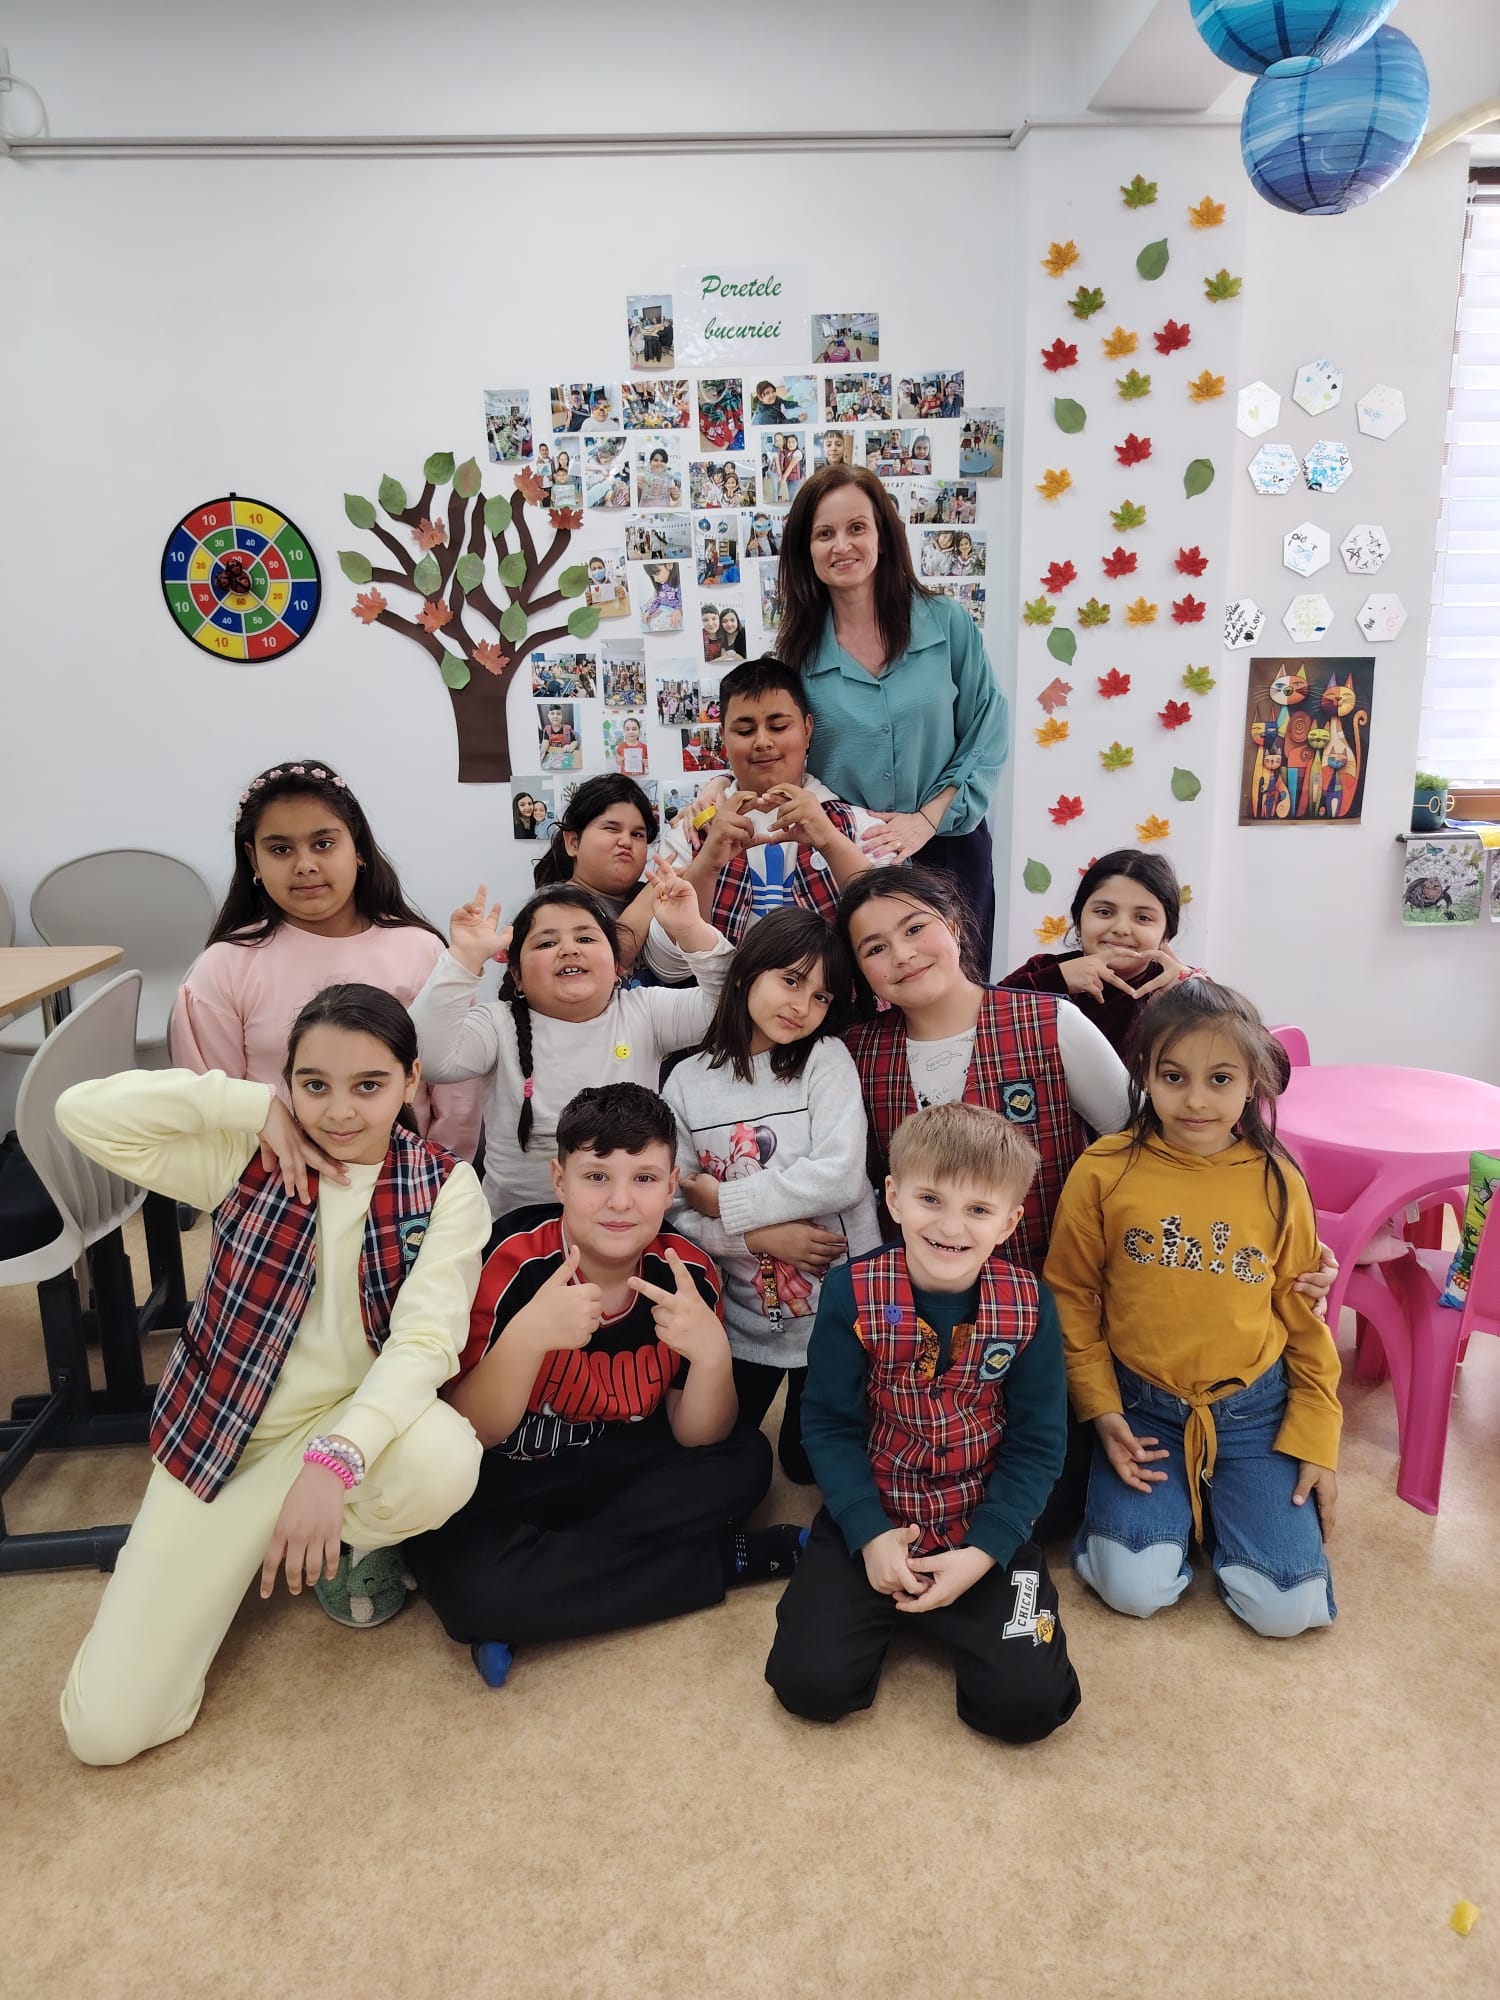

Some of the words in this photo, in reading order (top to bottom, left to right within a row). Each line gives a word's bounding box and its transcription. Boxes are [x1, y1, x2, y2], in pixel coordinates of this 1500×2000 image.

[701, 275, 782, 300] Peretele
[704, 317, 782, 340] bucuriei
[201, 515, 217, 526] 10
[249, 513, 264, 525] 10
[245, 539, 256, 547] 40
[170, 551, 185, 562] 10
[288, 549, 304, 561] 10
[195, 562, 206, 570] 20
[268, 560, 279, 569] 50
[255, 577, 266, 585] 70
[175, 601, 190, 613] 10
[293, 600, 309, 611] 10
[222, 617, 233, 625] 40
[252, 616, 263, 625] 50
[214, 637, 229, 648] 10
[261, 637, 277, 648] 10
[1017, 1577, 1034, 1627] CHICAGO
